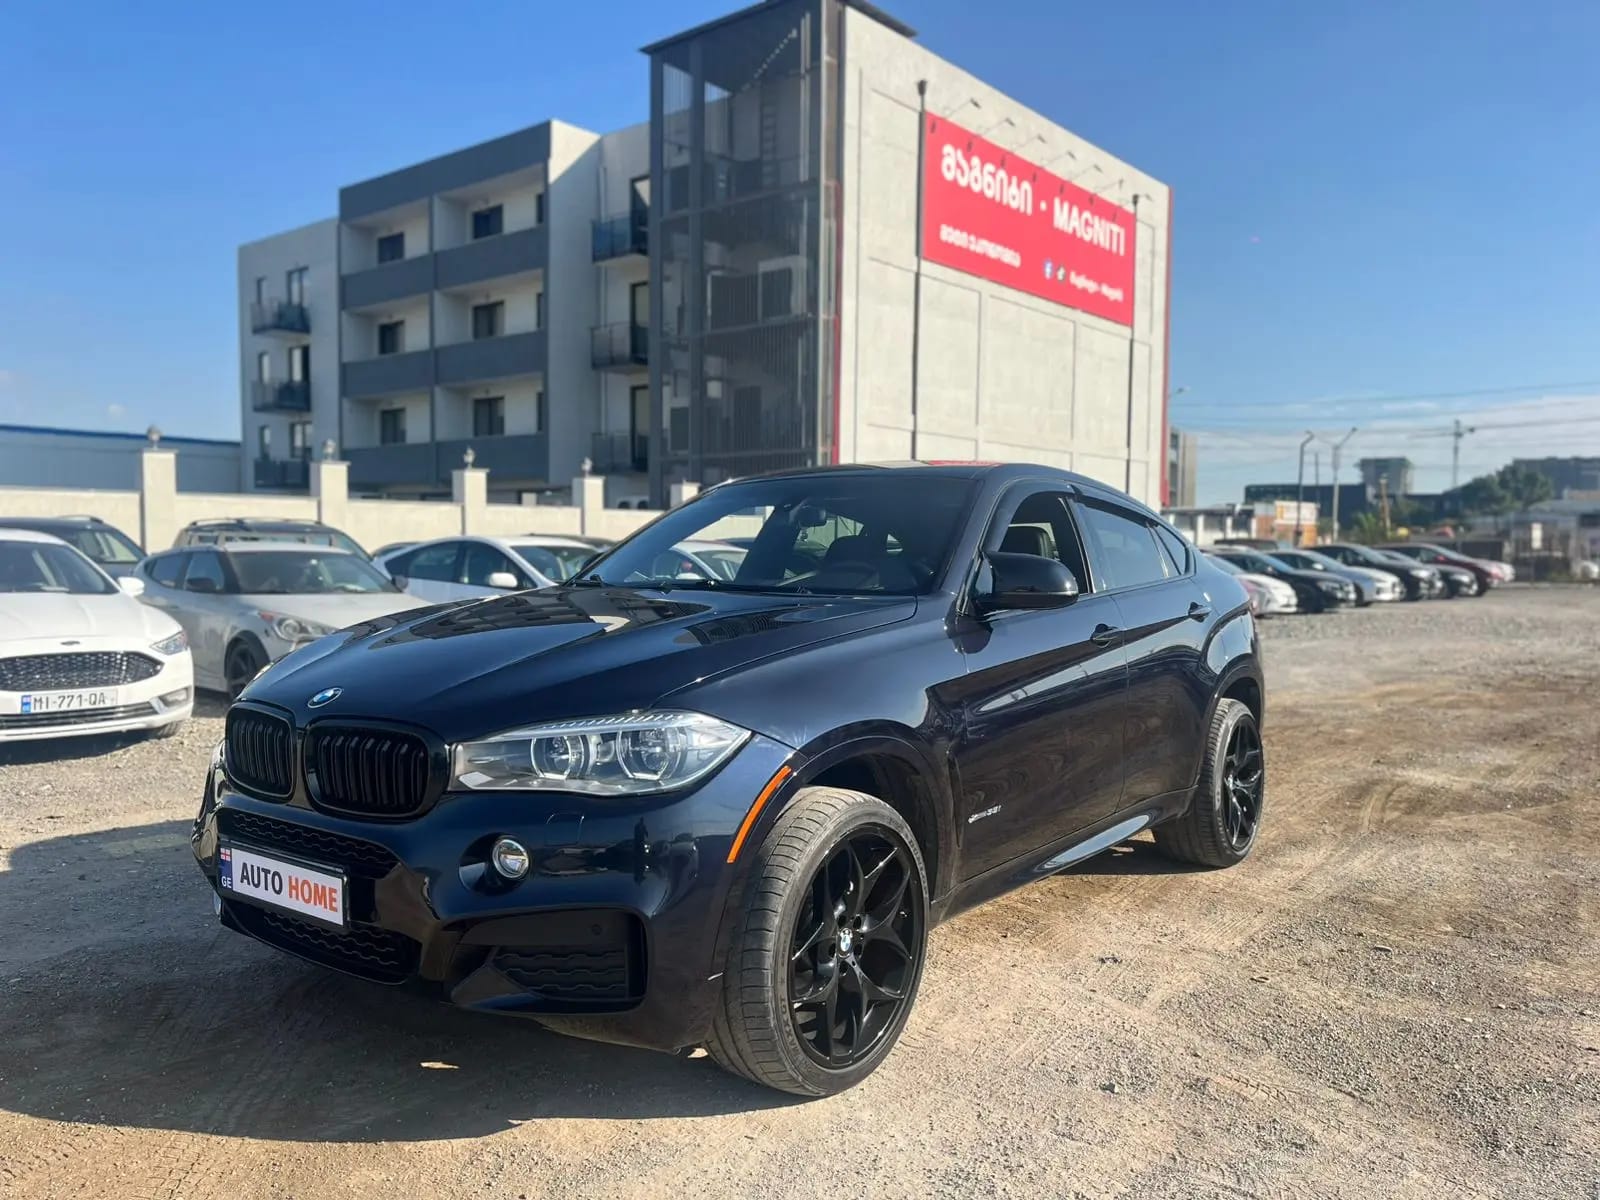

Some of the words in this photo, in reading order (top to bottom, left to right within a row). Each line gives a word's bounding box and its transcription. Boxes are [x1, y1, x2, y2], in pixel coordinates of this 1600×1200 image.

[941, 143, 1033, 217] მაგნიტი
[1053, 196, 1126, 257] MAGNITI
[221, 875, 232, 889] GE
[240, 861, 283, 895] AUTO
[288, 875, 338, 913] HOME
